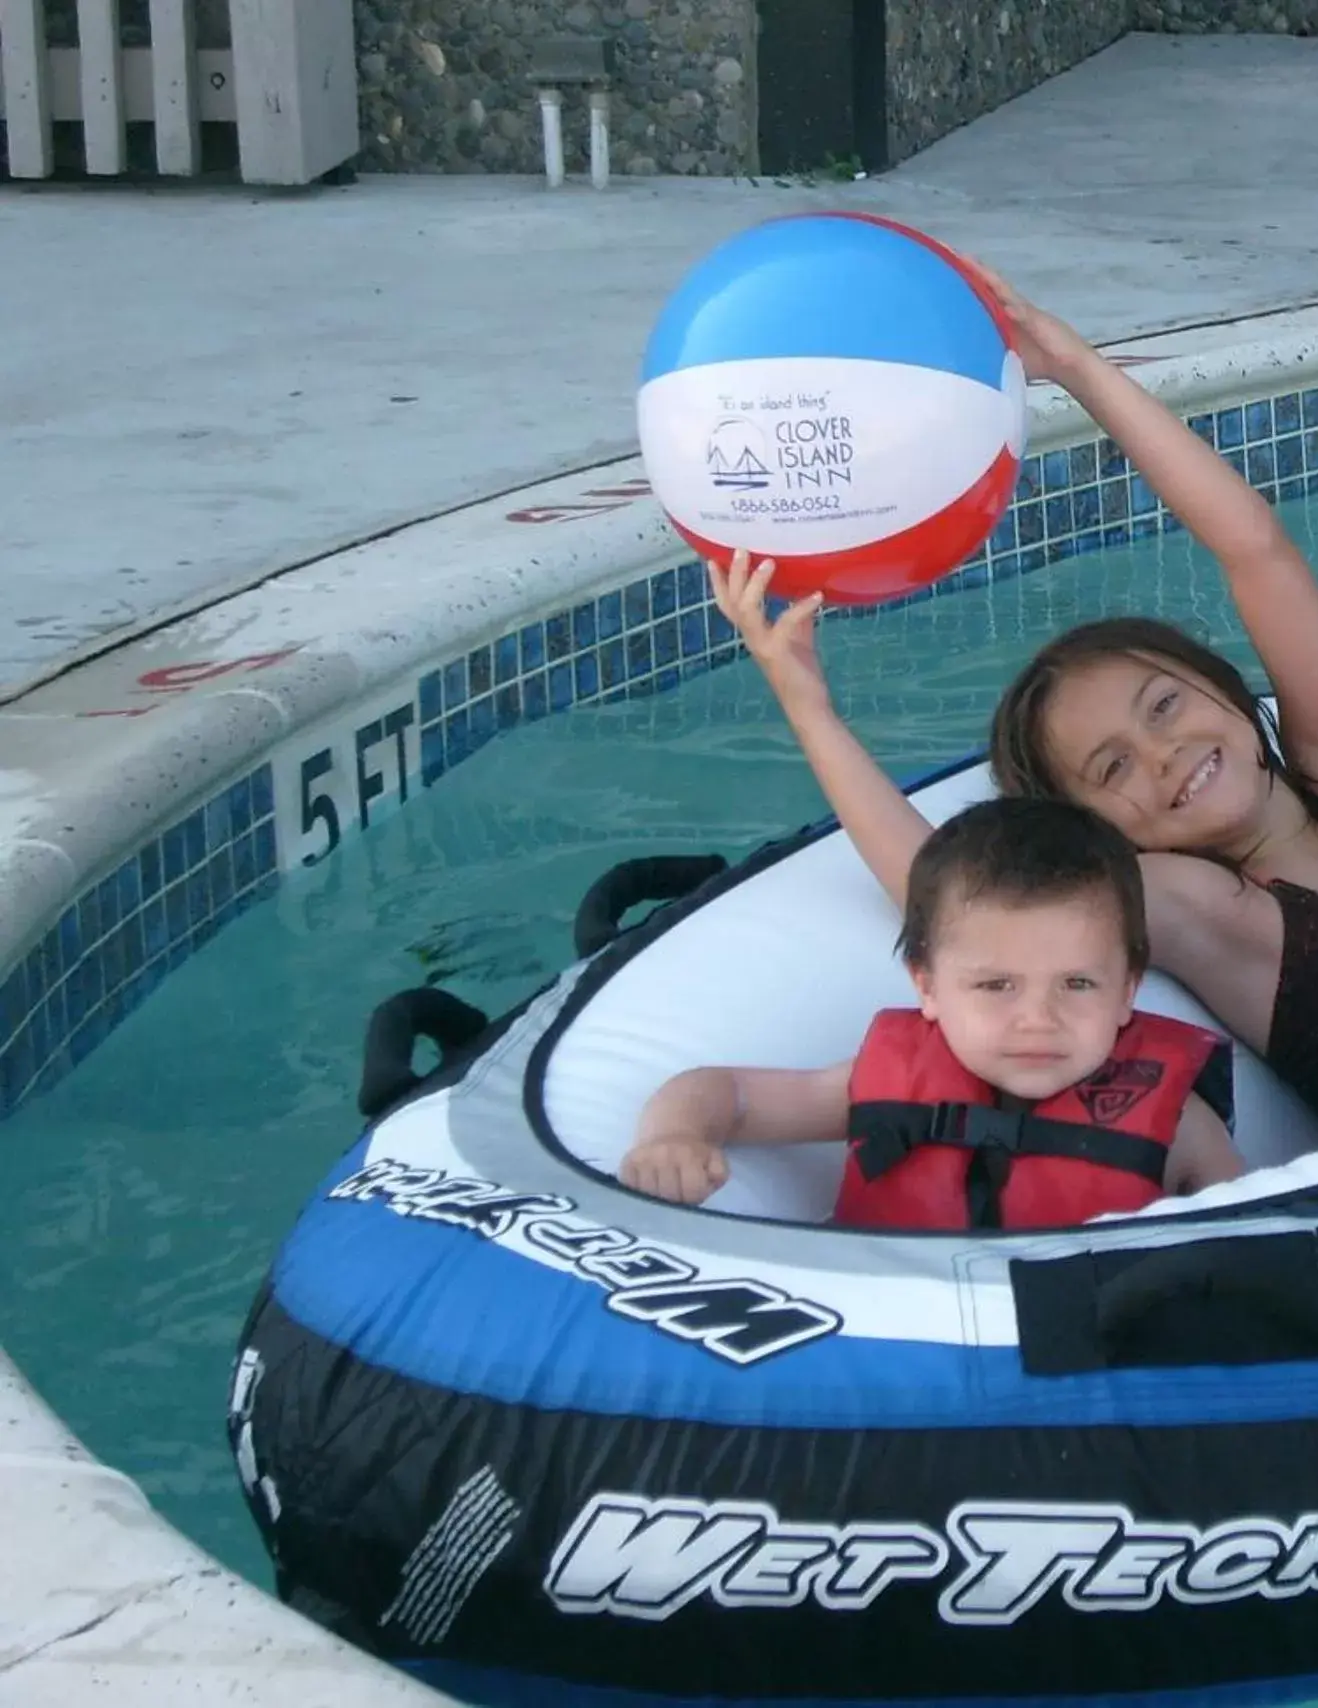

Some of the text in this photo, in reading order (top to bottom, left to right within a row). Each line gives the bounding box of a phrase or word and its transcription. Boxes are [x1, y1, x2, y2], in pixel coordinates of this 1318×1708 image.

[776, 416, 852, 443] CLOVER
[778, 441, 854, 468] ISLAND
[785, 466, 852, 490] INN
[301, 701, 414, 867] 5 FT
